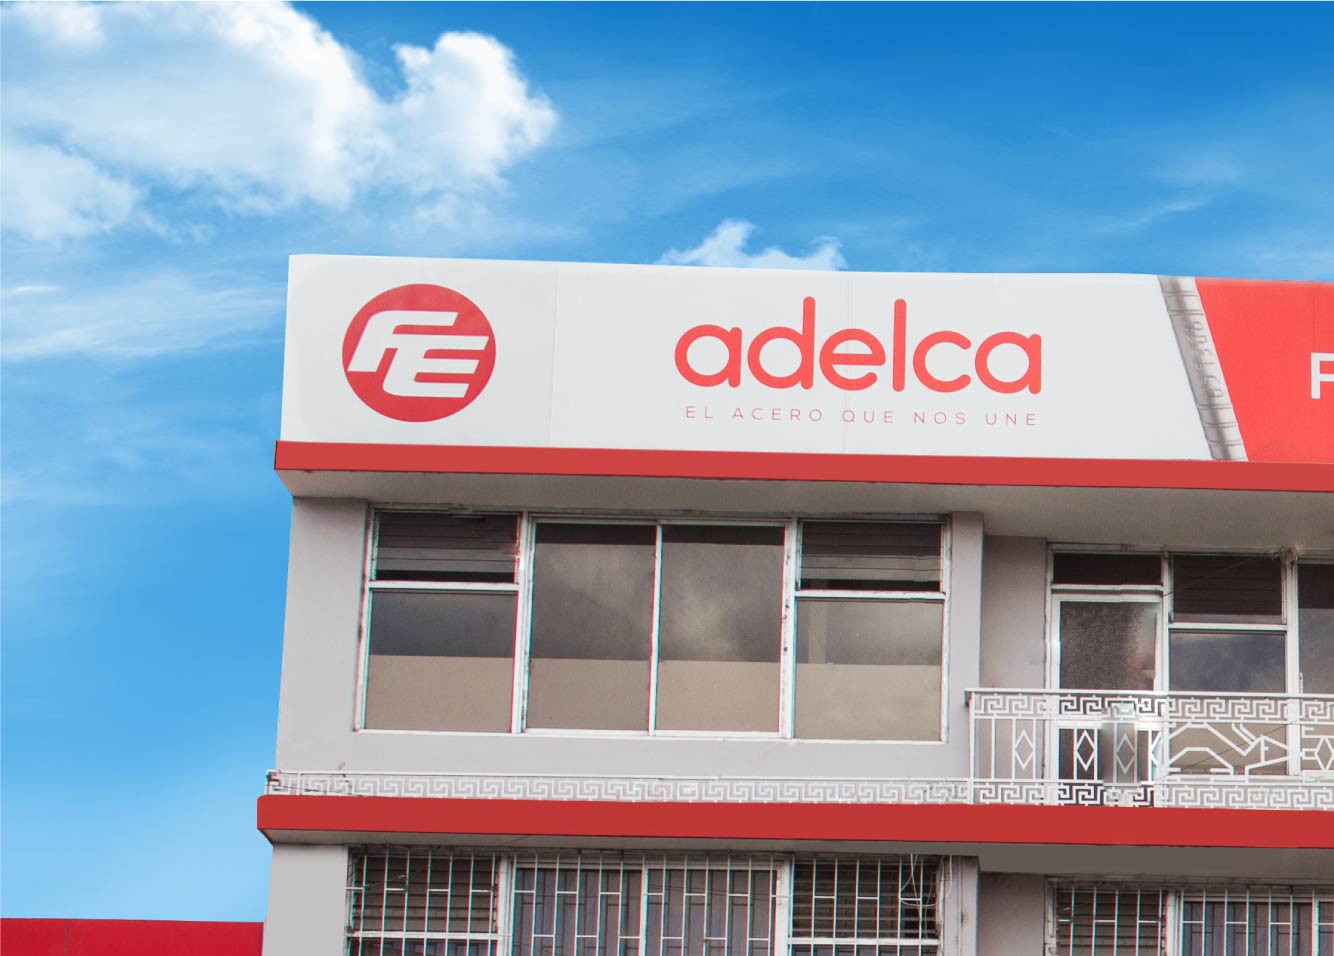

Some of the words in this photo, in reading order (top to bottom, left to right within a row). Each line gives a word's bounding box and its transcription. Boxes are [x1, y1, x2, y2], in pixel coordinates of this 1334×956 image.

[674, 296, 1043, 395] adelca
[684, 404, 713, 420] EL
[731, 404, 823, 423] ACERO
[841, 408, 895, 425] QUE
[911, 411, 967, 426] NOS
[984, 412, 1038, 428] UNE
